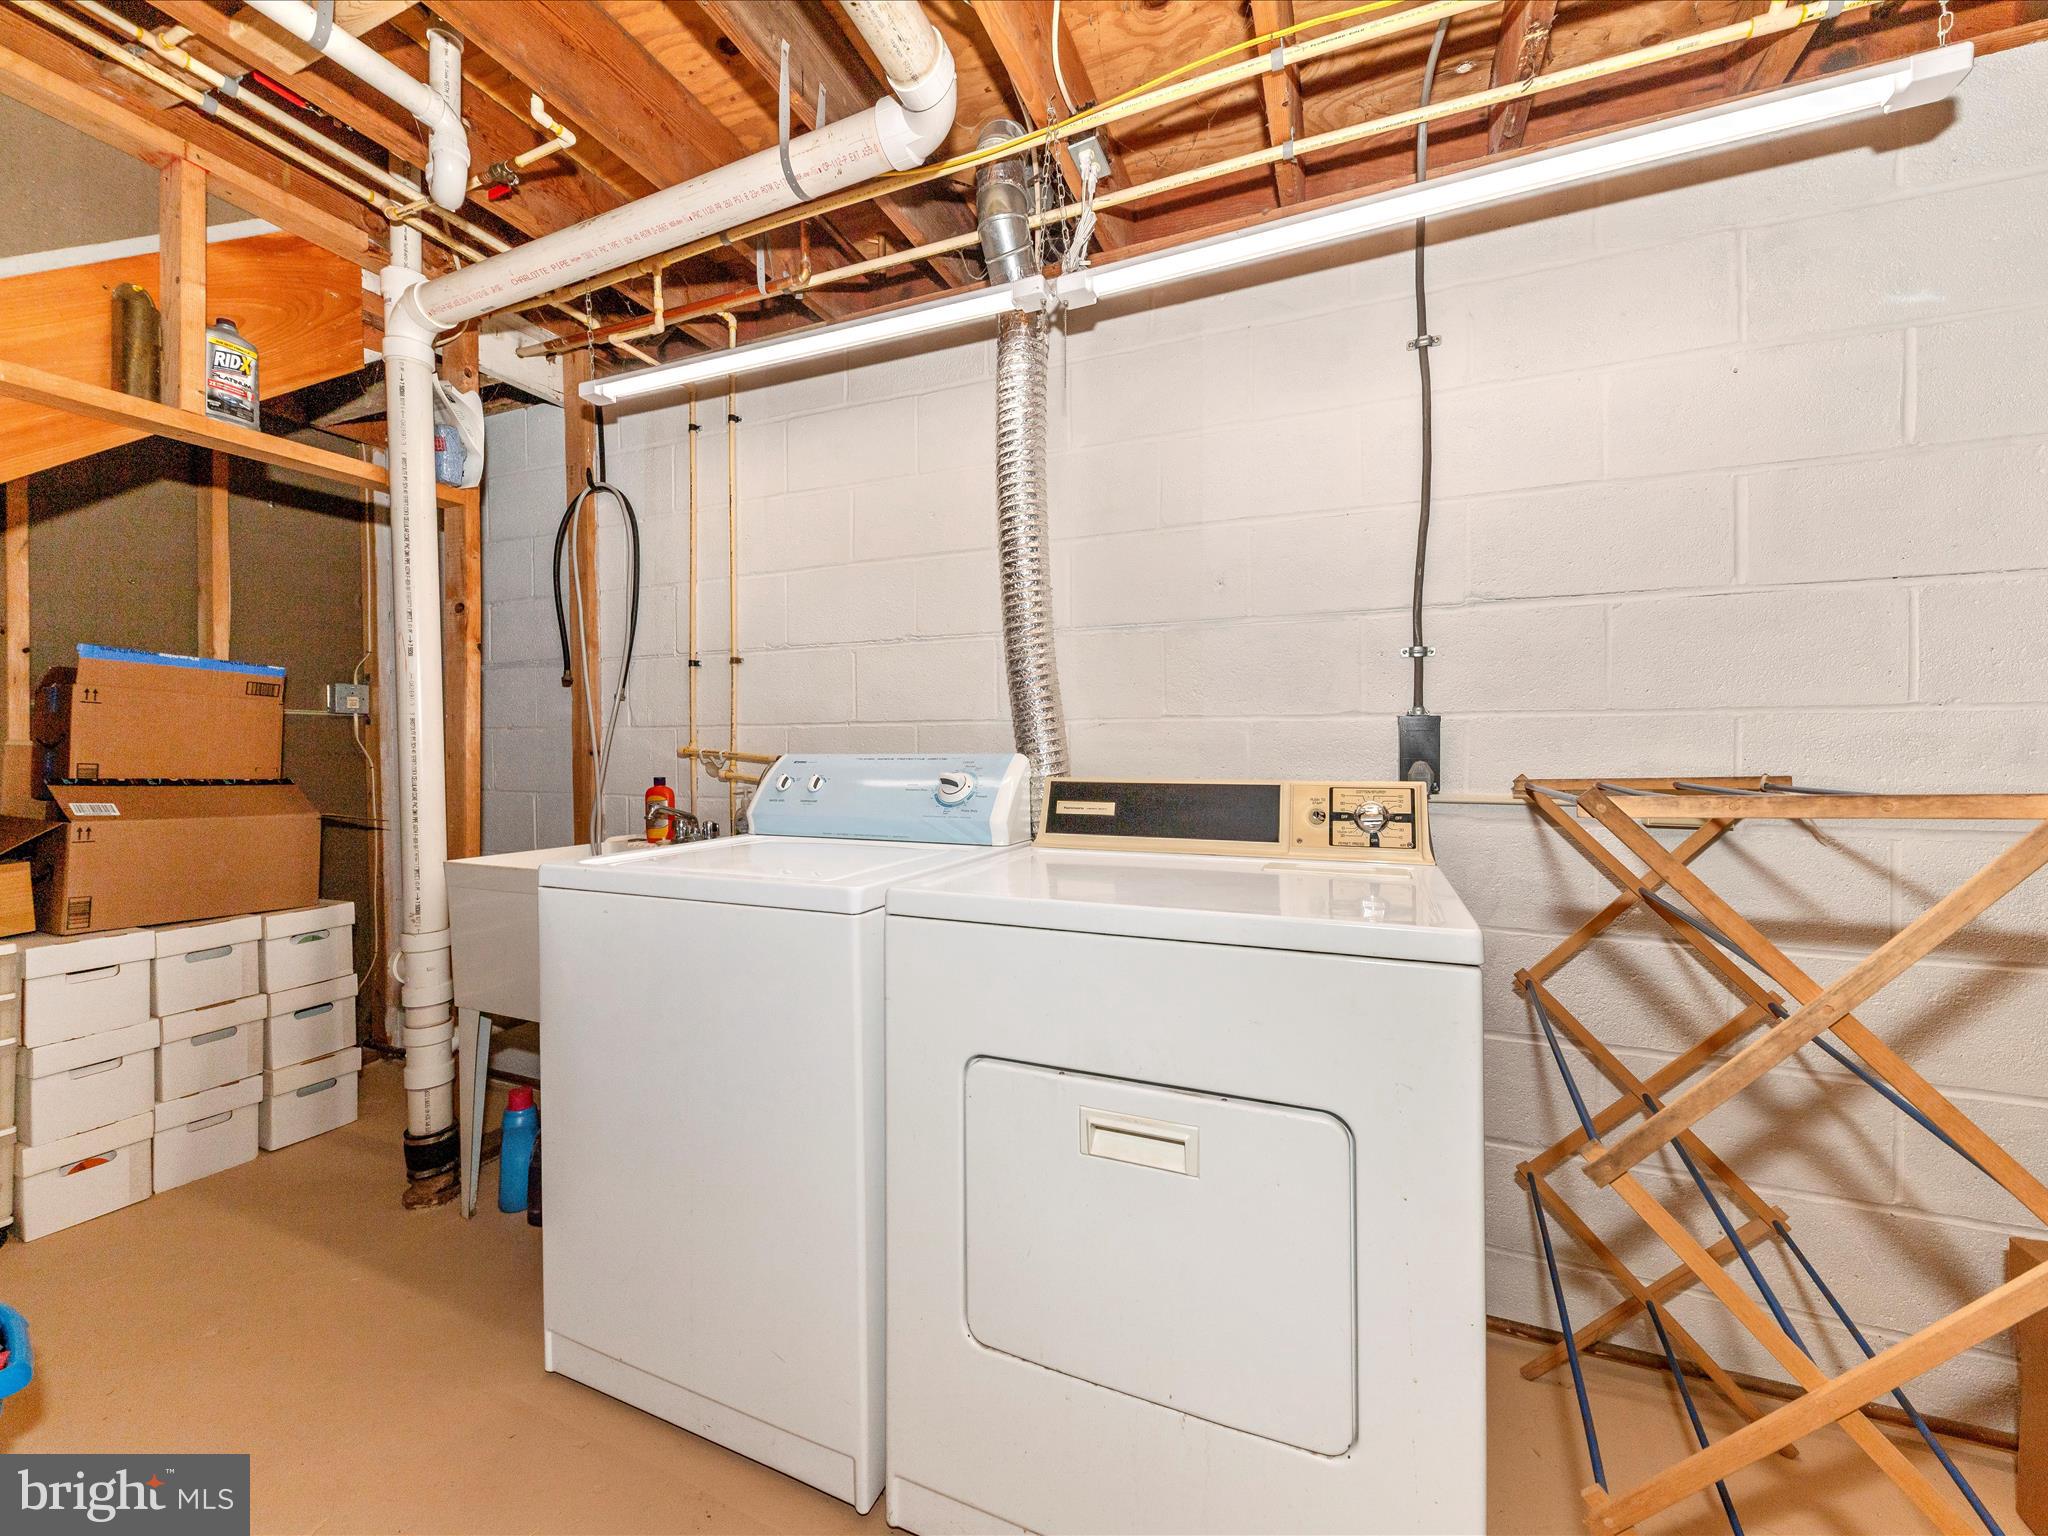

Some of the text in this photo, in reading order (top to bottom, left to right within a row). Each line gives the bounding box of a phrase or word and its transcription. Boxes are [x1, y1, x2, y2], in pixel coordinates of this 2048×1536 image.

[511, 267, 550, 286] CHARLOTTE
[552, 259, 572, 272] PIPE
[211, 372, 252, 390] PLATINUM
